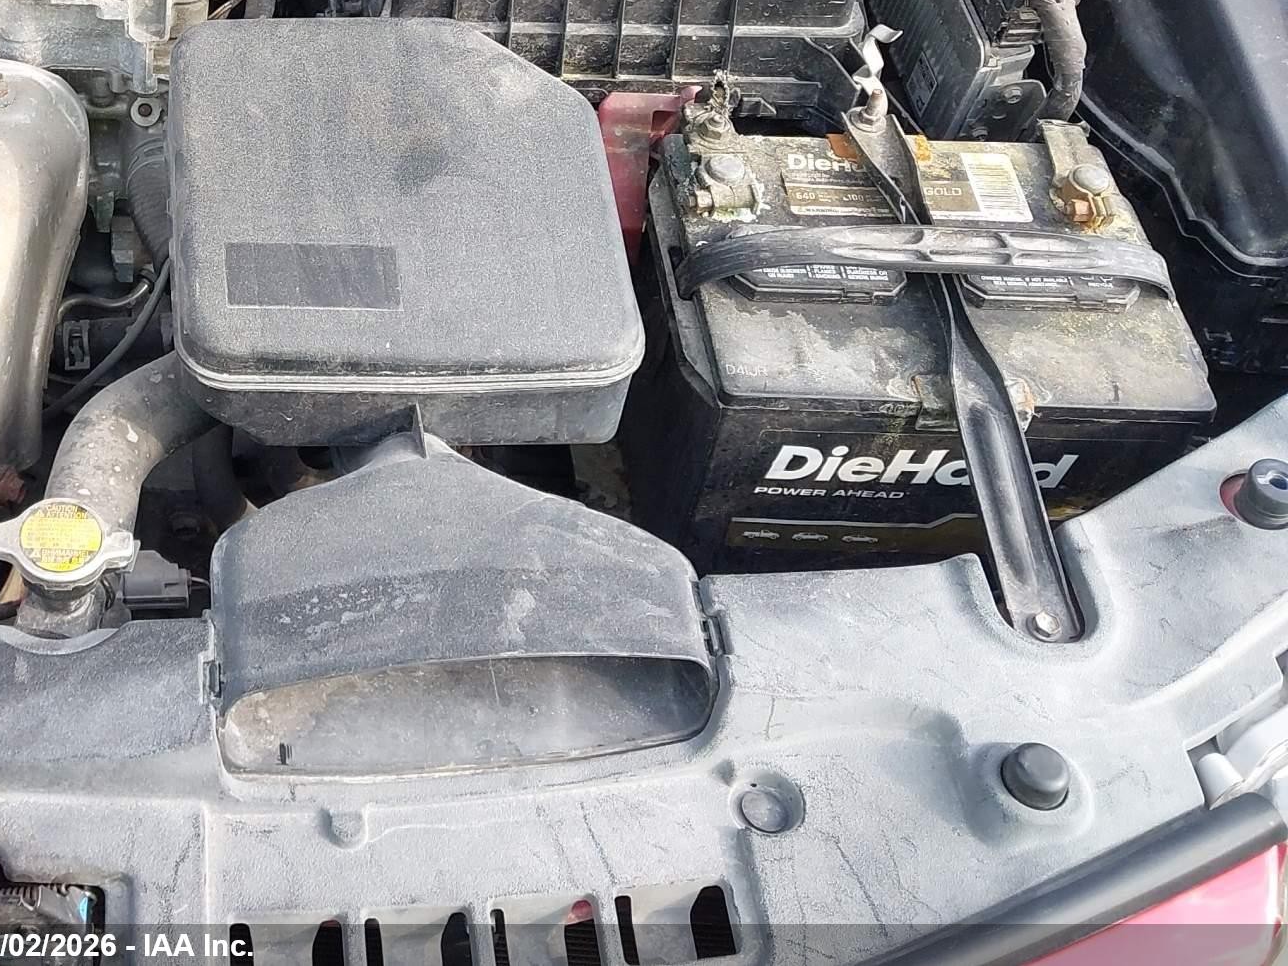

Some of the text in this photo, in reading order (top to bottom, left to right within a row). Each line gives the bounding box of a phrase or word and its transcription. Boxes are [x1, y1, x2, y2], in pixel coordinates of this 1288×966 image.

[924, 187, 962, 196] GOLD
[764, 445, 1079, 489] DieHad
[753, 486, 905, 500] POWER AHEAD
